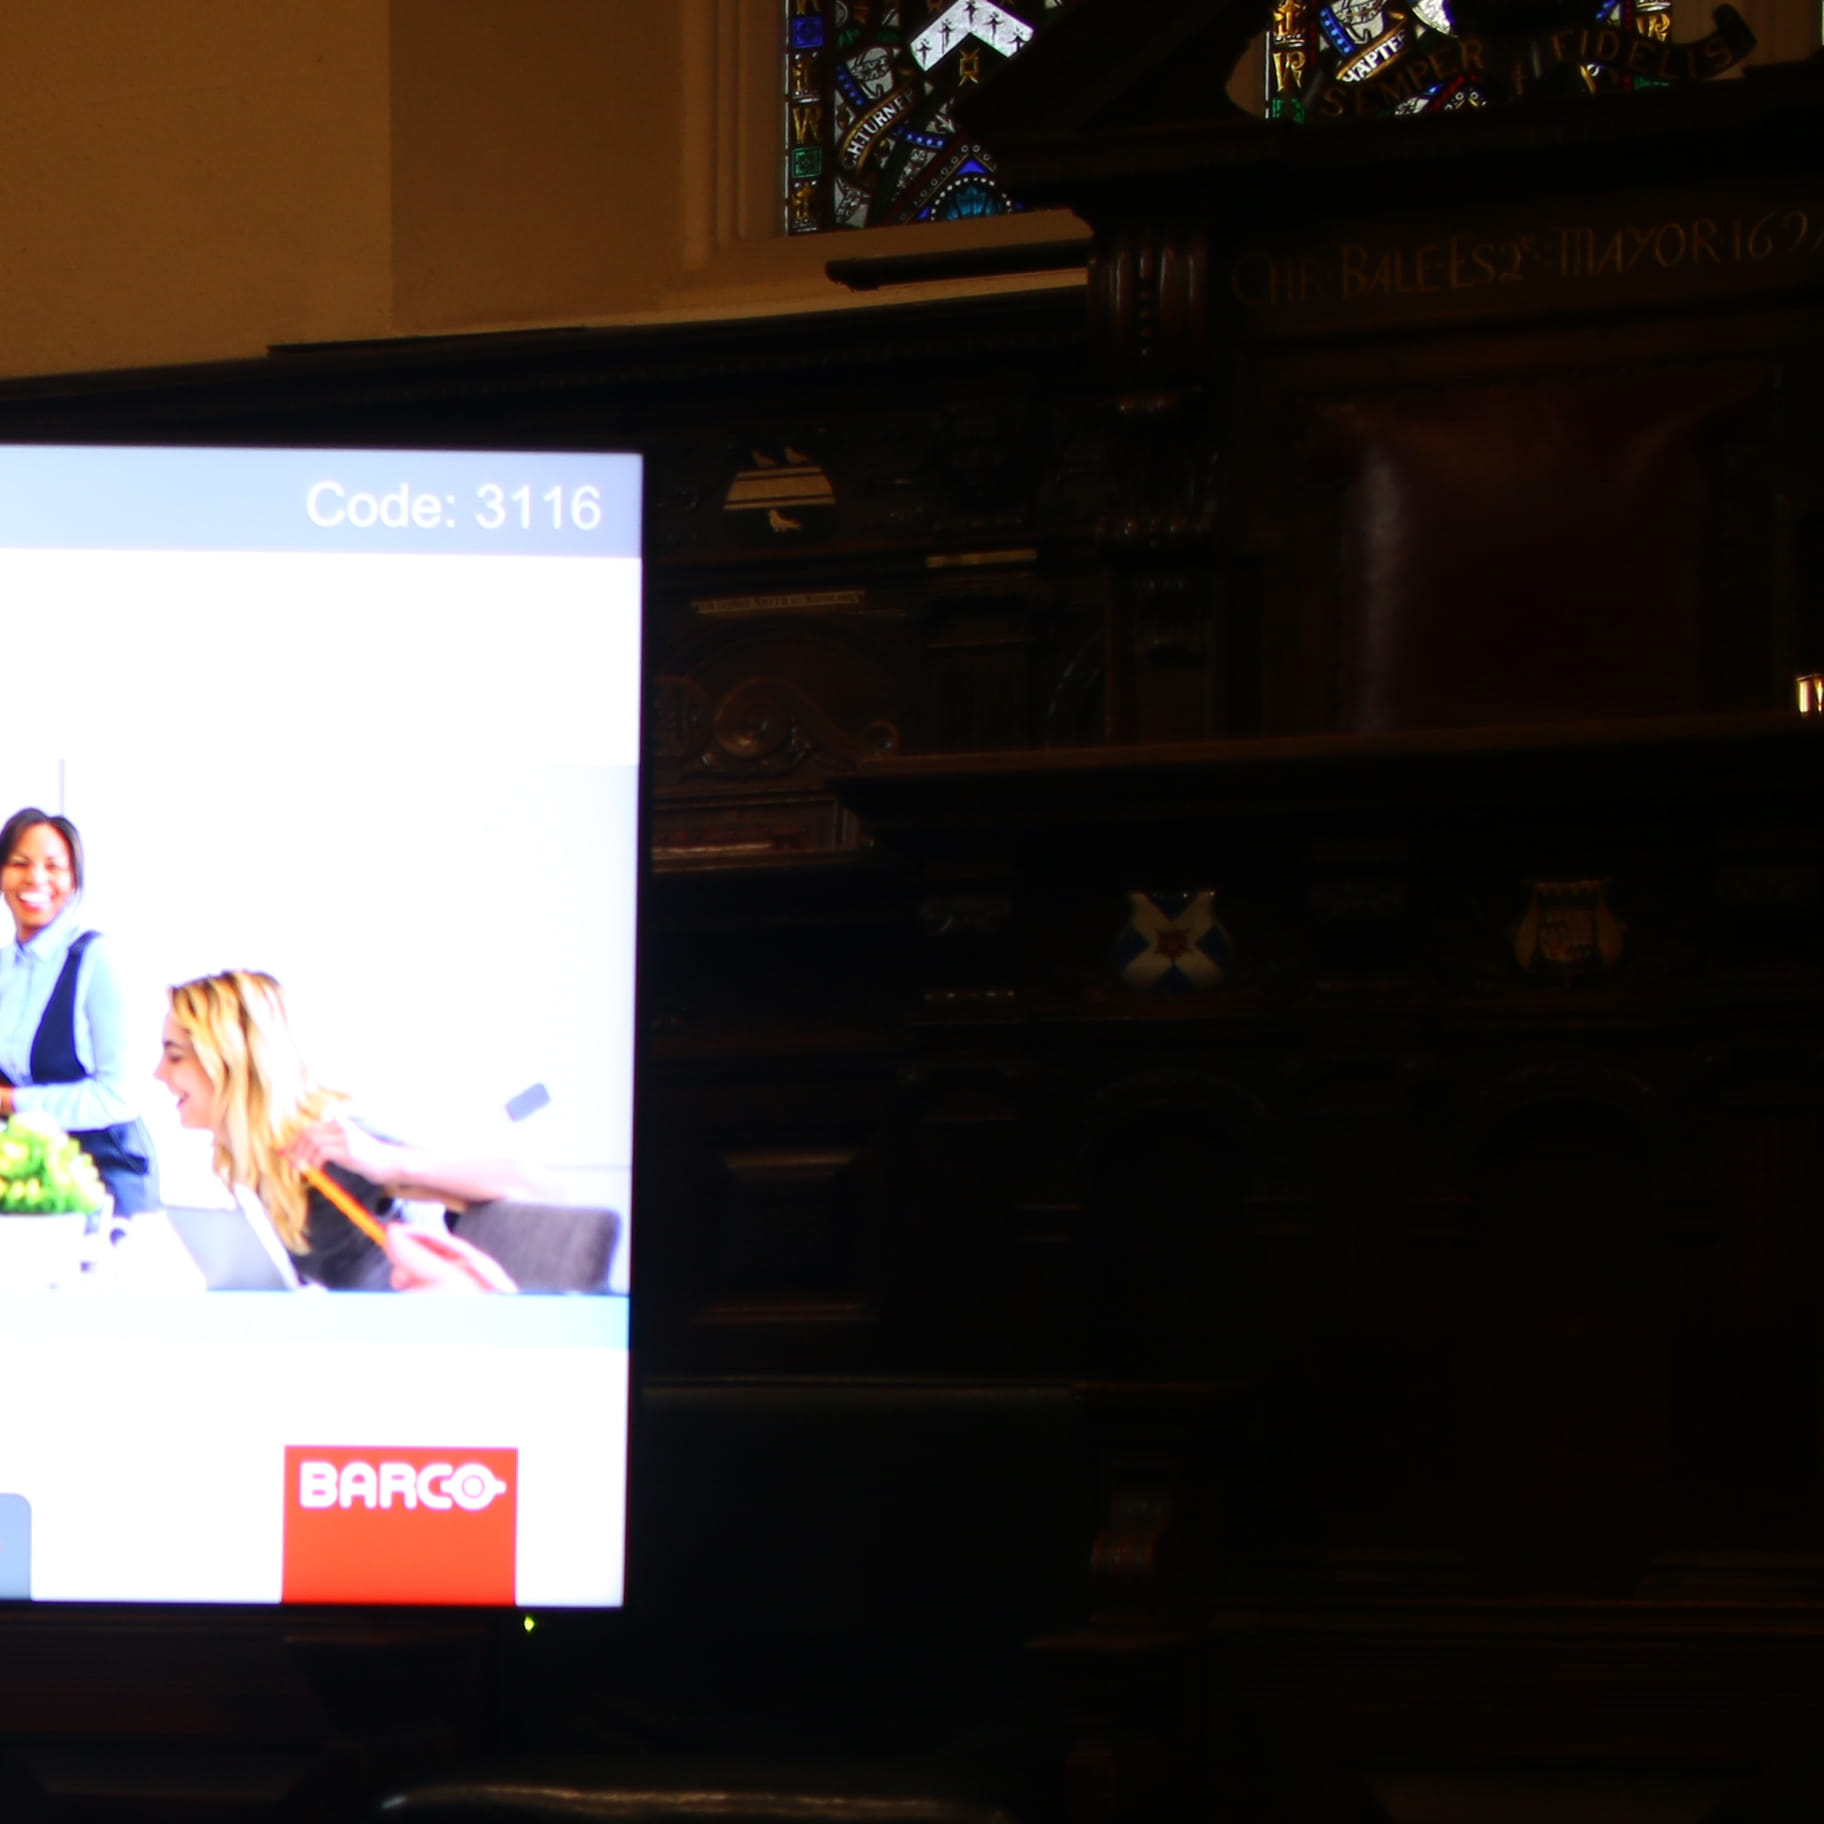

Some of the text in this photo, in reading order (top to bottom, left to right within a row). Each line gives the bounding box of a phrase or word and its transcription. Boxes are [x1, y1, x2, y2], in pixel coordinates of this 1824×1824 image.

[1320, 25, 1734, 119] SEMPER FIDELIS
[1552, 215, 1721, 279] MAYOR
[306, 480, 602, 531] Code: 3116
[298, 1459, 508, 1511] BARCO
